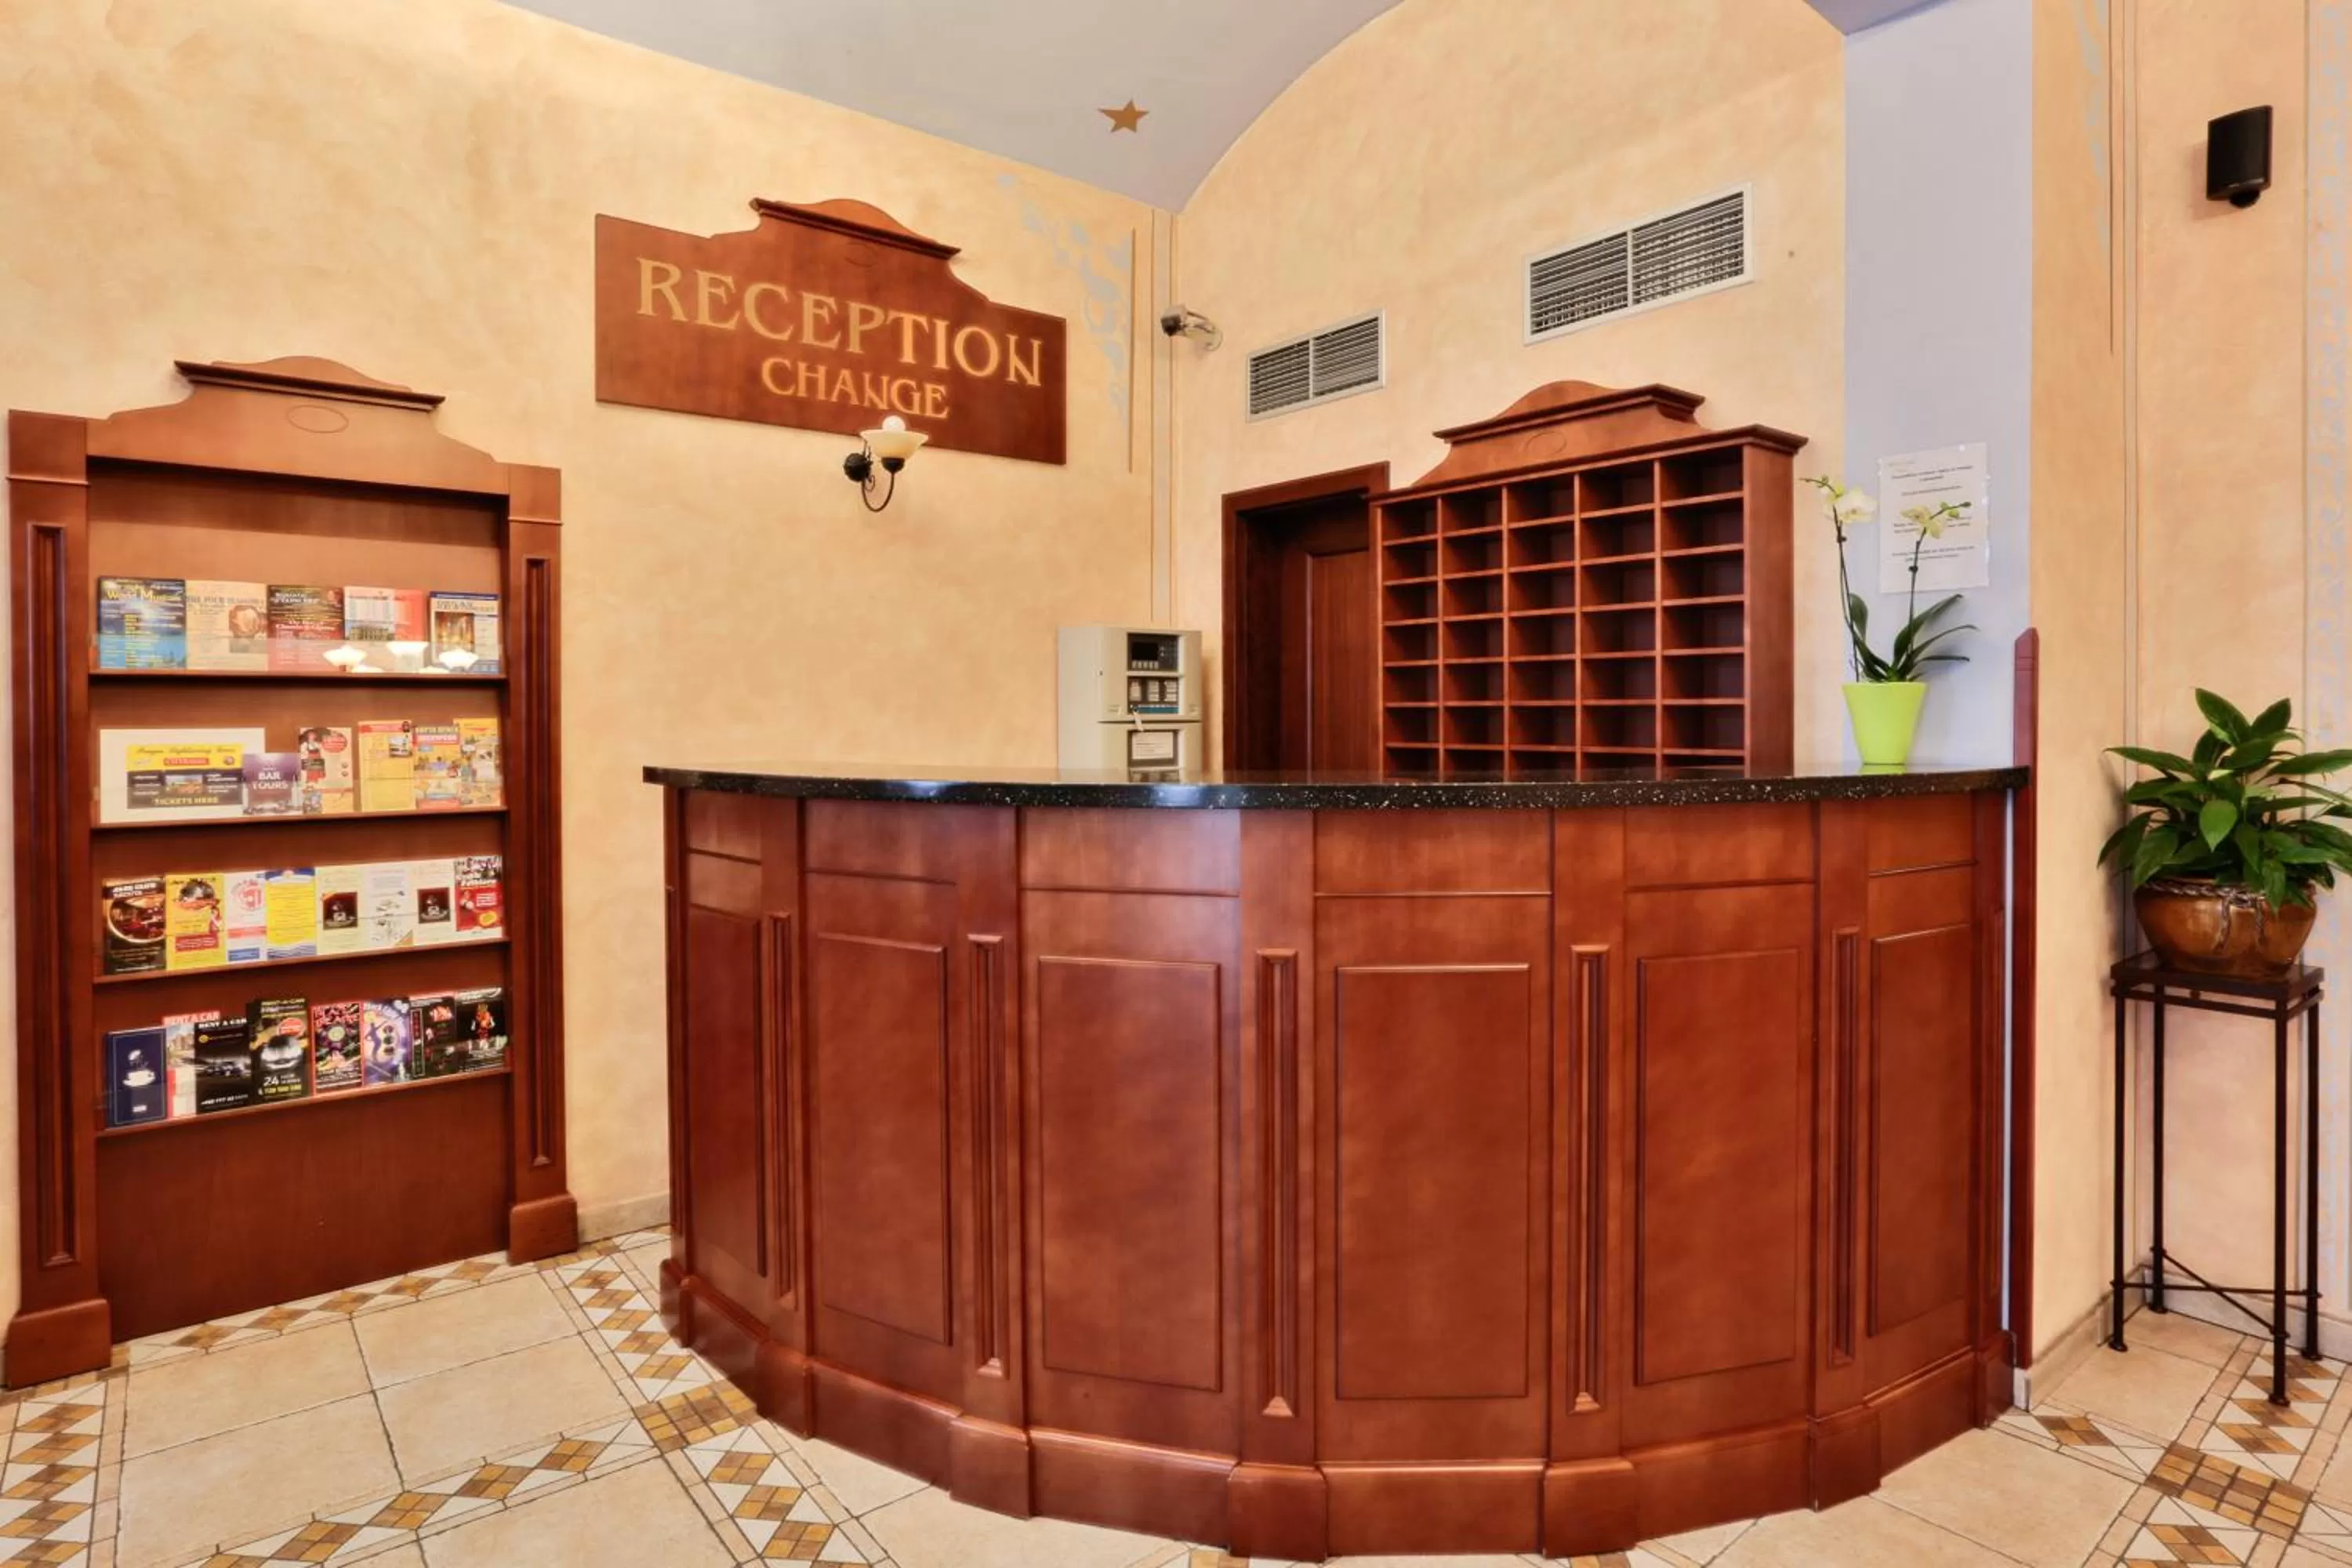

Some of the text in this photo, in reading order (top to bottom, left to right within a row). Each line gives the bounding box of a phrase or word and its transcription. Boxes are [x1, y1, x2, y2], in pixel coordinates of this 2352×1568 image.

[637, 257, 1042, 387] RECEPTION
[761, 358, 949, 419] CHANGE
[259, 771, 281, 780] BAR
[252, 781, 289, 790] TOURS
[263, 1075, 280, 1087] 24
